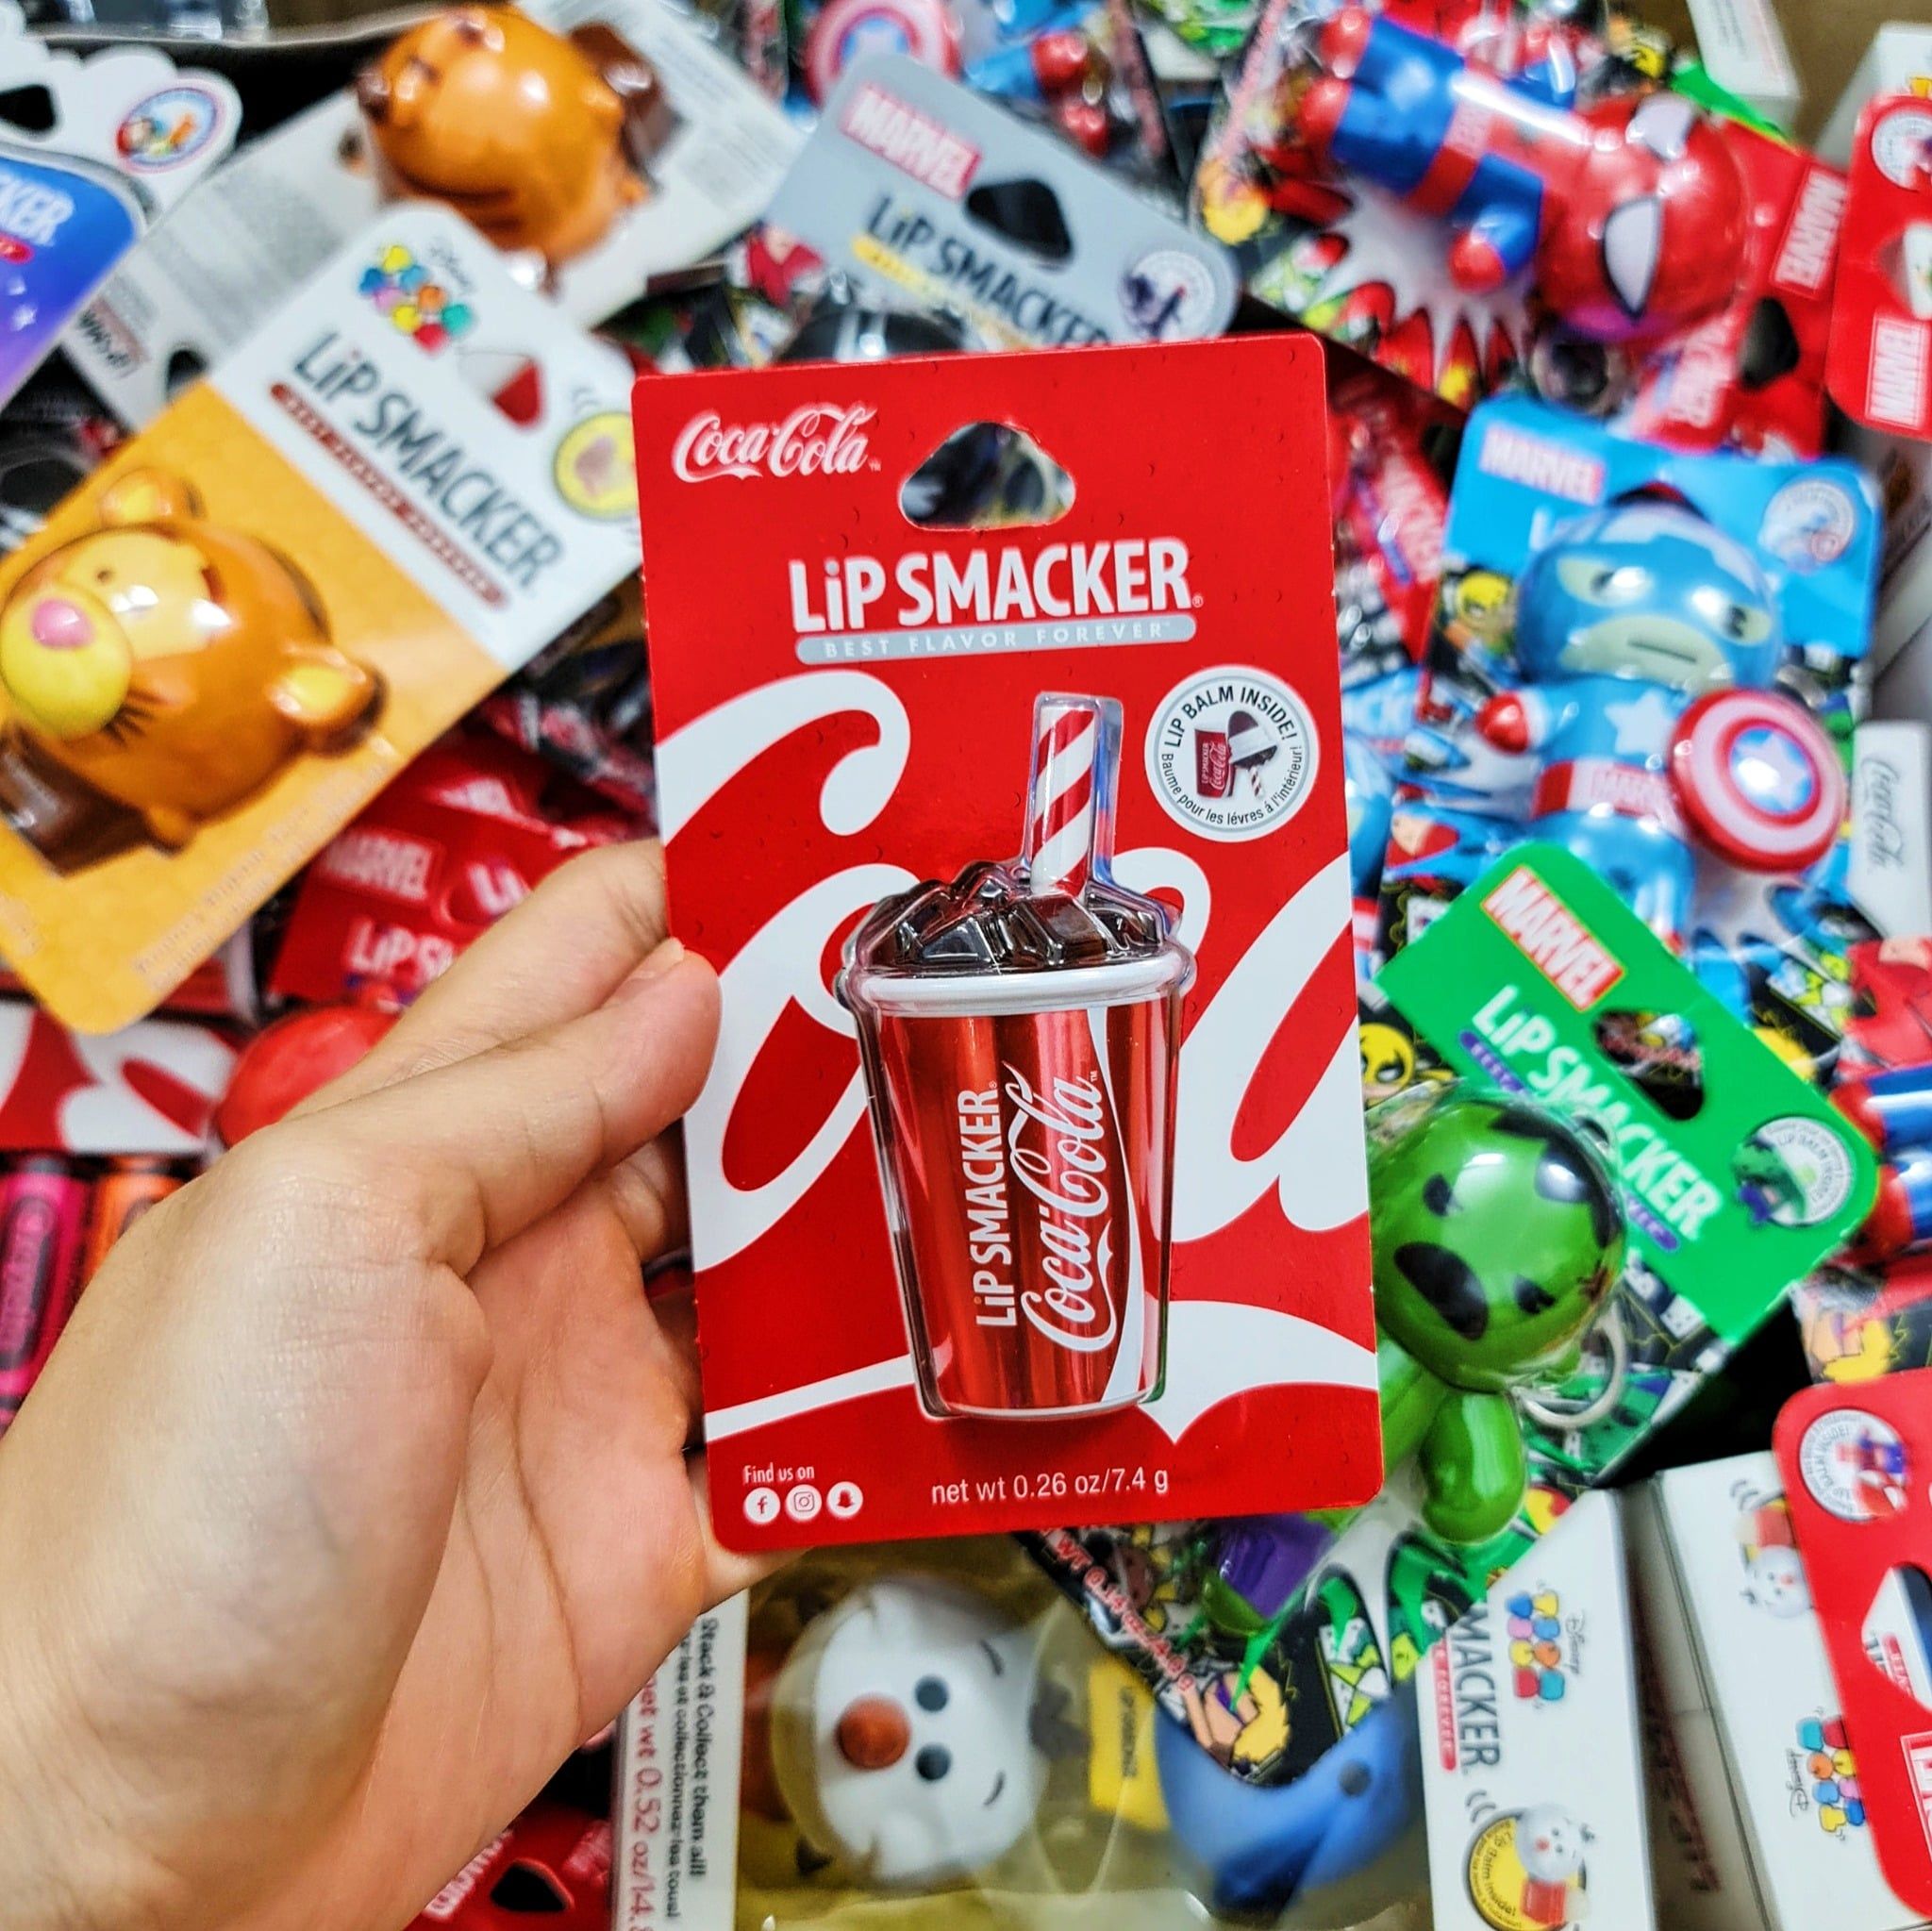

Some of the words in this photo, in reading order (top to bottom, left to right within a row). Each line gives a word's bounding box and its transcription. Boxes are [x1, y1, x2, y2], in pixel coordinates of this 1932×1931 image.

[841, 85, 978, 198] MARVEL
[864, 192, 938, 259] LiP
[290, 325, 389, 412] LiP
[351, 383, 570, 593] SMACKER
[674, 402, 877, 482] Coca-Cola
[790, 557, 886, 633] LiP
[898, 536, 1191, 627] SMACKER
[824, 639, 890, 659] BEST
[909, 628, 1018, 654] FLAVOR
[1038, 621, 1162, 643] FOREVER
[1164, 718, 1186, 748] LIP
[1182, 686, 1235, 721] BALM
[1240, 687, 1298, 741] INSIDE!
[1161, 753, 1181, 795] Baume
[1177, 794, 1206, 817] pour
[1207, 808, 1224, 824] les
[1481, 867, 1624, 1009] MARVEL
[1469, 981, 1561, 1061] LiP
[957, 1089, 1015, 1264] SMACKER
[1002, 1059, 1115, 1352] Coca-Cola
[975, 1270, 1018, 1327] LiP
[742, 1465, 775, 1483] Find
[779, 1467, 794, 1482] us
[796, 1465, 815, 1480] on
[931, 1478, 969, 1503] net
[975, 1478, 1007, 1502] wt
[1013, 1473, 1068, 1499] 0.26
[1074, 1469, 1147, 1496] oz/7.4
[1155, 1468, 1170, 1495] g
[1452, 1605, 1500, 1767] MACKER
[640, 1724, 658, 1759] wt
[693, 1703, 714, 1779] Collect
[635, 1767, 661, 1833] 0.52
